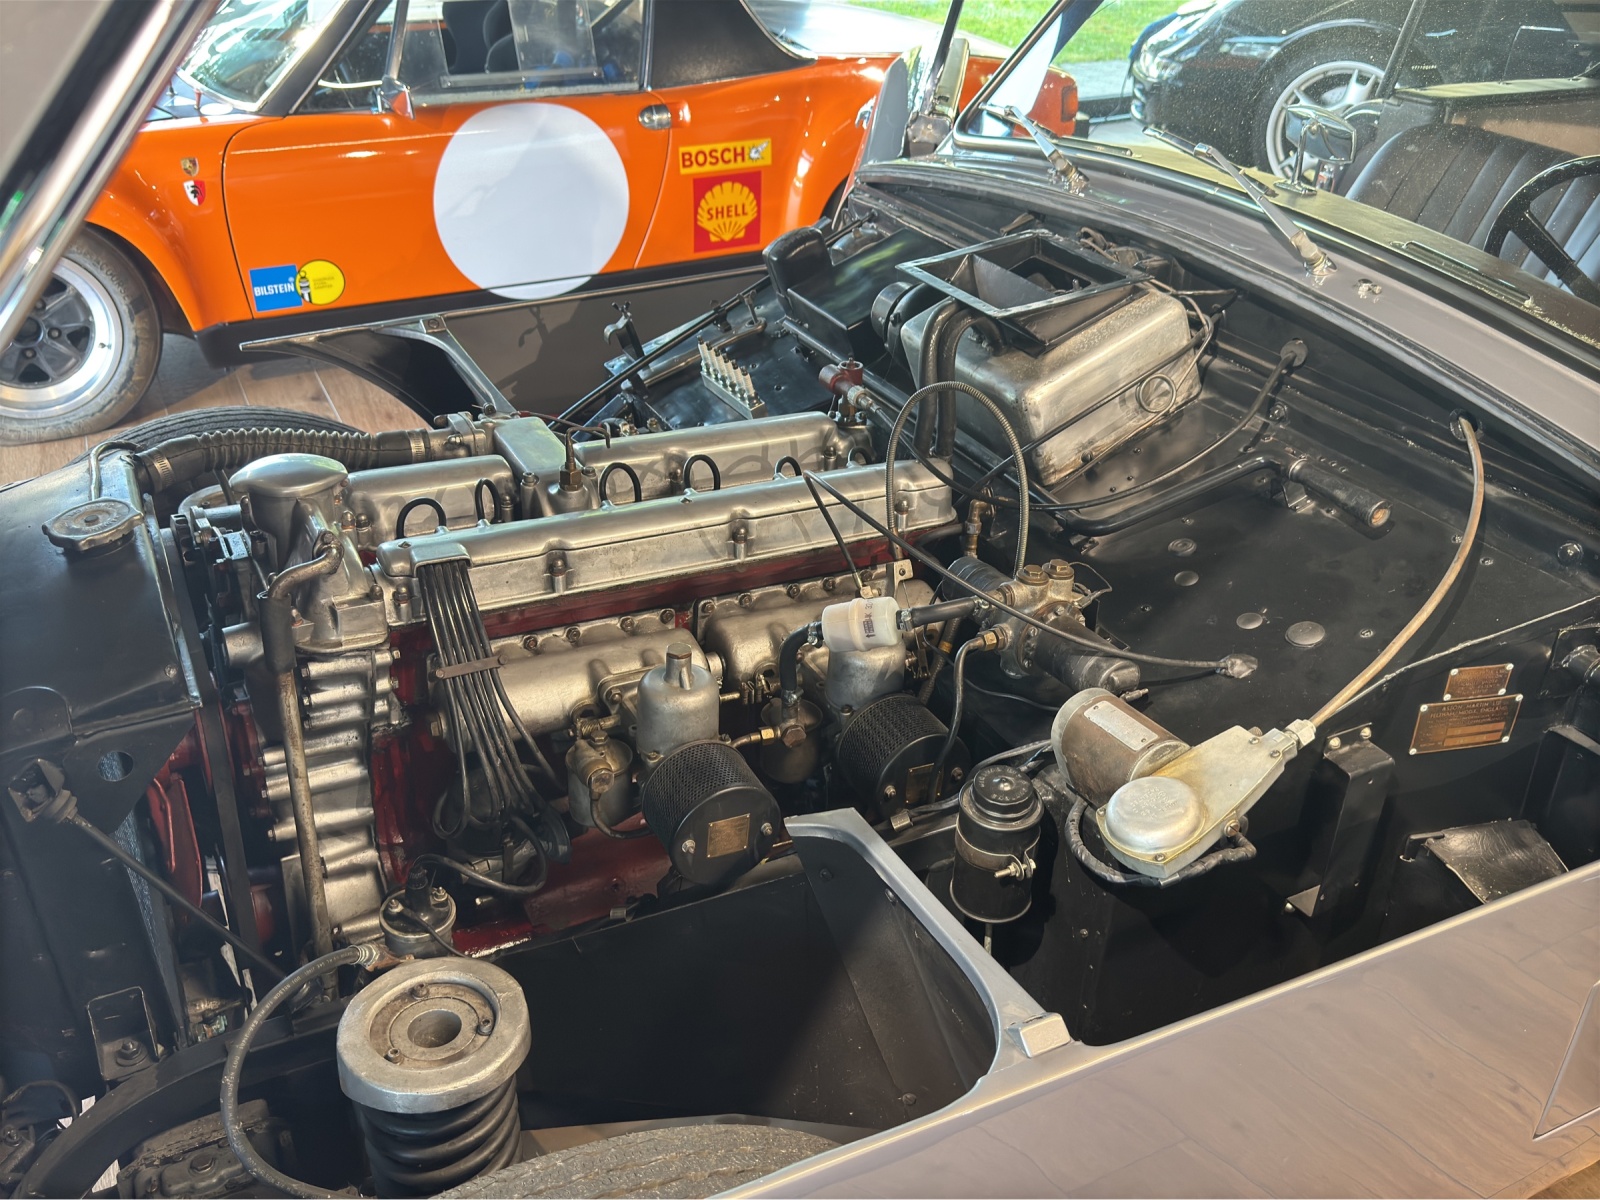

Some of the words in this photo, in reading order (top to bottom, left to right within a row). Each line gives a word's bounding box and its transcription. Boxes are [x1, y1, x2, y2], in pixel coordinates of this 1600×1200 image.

[681, 146, 746, 169] BOSCH
[706, 203, 748, 221] SHELL
[253, 282, 295, 297] BILSTEIN
